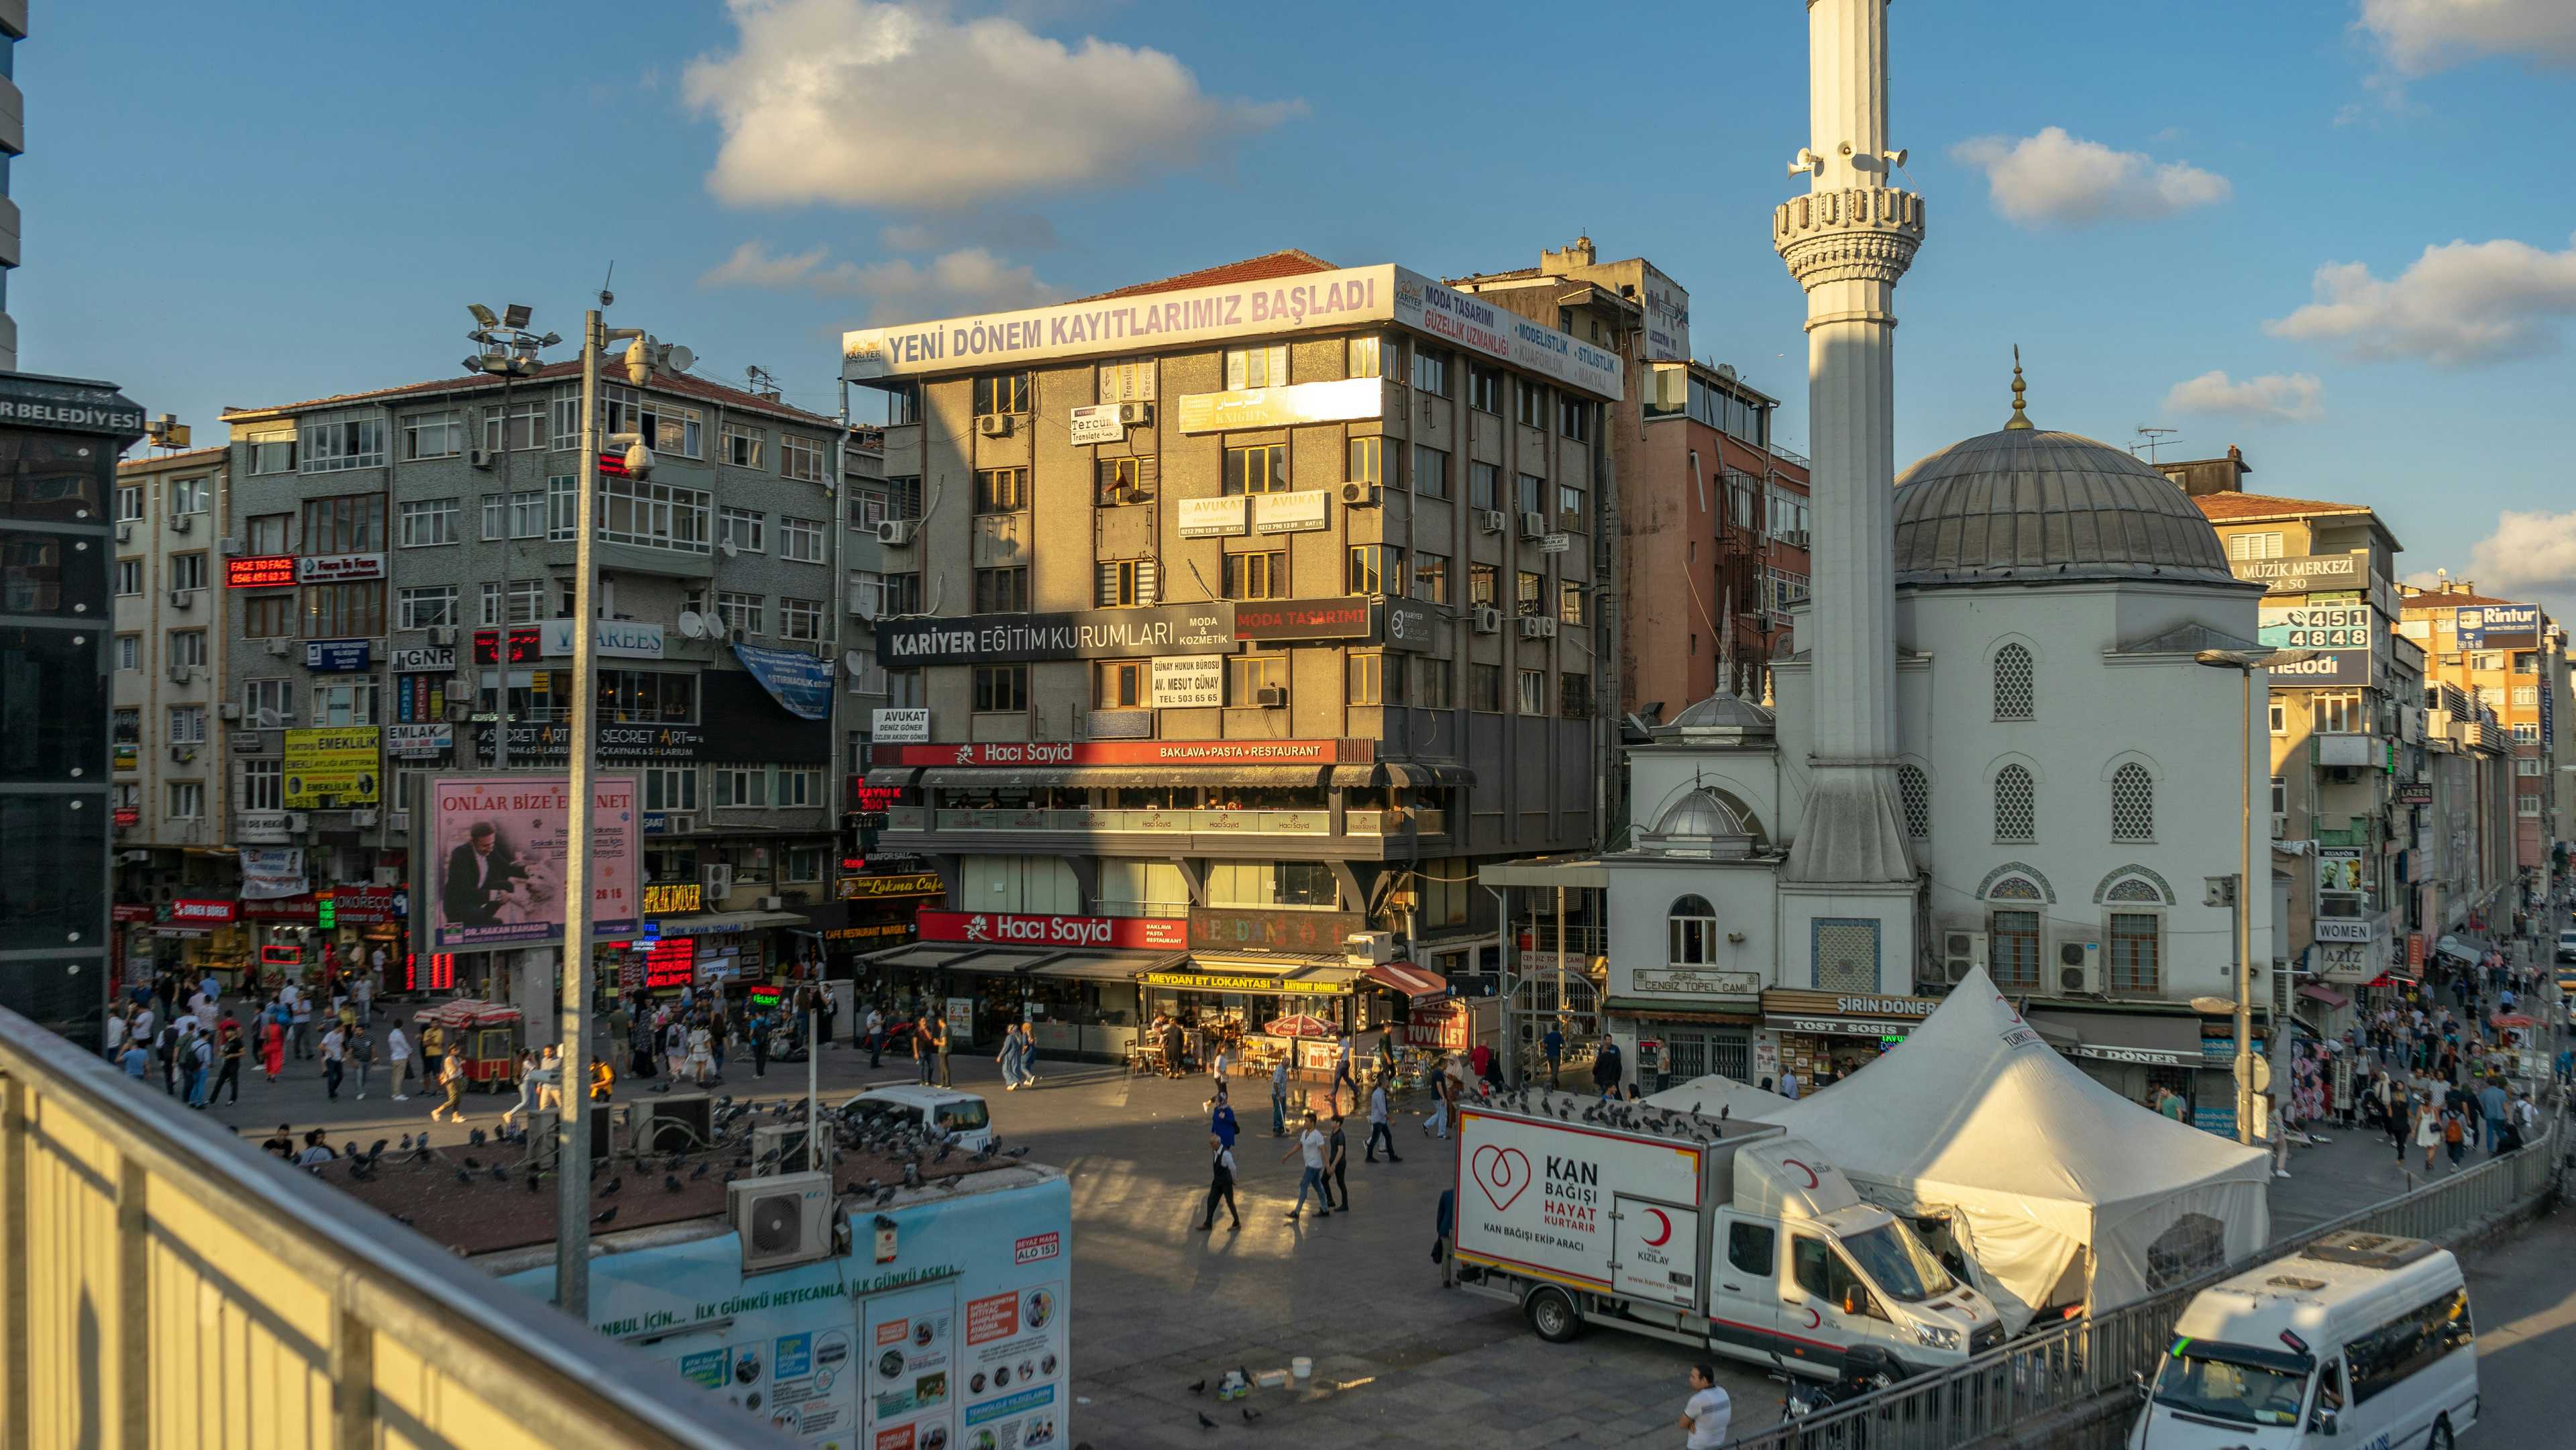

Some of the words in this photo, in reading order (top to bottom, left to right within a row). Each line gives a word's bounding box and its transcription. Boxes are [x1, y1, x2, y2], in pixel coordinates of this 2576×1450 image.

[1426, 284, 1452, 311] MODA
[1454, 296, 1494, 328] TASARIMI
[888, 324, 944, 364] YENİ
[953, 320, 1042, 357] DÖNEM
[1051, 294, 1242, 345] KAYITLARIMIZ
[1251, 278, 1375, 325] BAŞLADI
[1424, 309, 1464, 342] GÜZELLİK
[1466, 325, 1509, 357] UZMANLIĞI
[1519, 322, 1568, 356] MODELİSTLİK
[1519, 348, 1564, 374] KUAFÖRLÜK
[1578, 346, 1615, 374] STİLİSTLİK
[1578, 366, 1606, 391] MAKYAJ
[17, 403, 142, 429] BELEDİYESİ
[1215, 410, 1268, 424] KNIGHTS
[1073, 432, 1100, 441] Translate
[1194, 499, 1244, 512] AVUKAT
[1271, 493, 1322, 507] AVUKAT
[2243, 561, 2290, 578] MÜZİK
[2292, 557, 2354, 576] MERKEZİ
[2288, 578, 2307, 589] 50
[1189, 617, 1218, 627] MODA
[1237, 613, 1283, 627] MODA
[2483, 607, 2536, 623] Rintur
[892, 627, 976, 656] KARİYER
[981, 623, 1046, 652] EĞİTİM
[1052, 621, 1173, 649] KURUMLARI
[1200, 627, 1207, 635] &
[1179, 634, 1228, 645] KOZMETİK
[408, 651, 453, 665] GNR
[1155, 661, 1173, 671] GÜNAY
[1175, 662, 1194, 670] HUKUK
[1195, 660, 1219, 670] BÜROSU
[1155, 682, 1165, 691] AV.
[1168, 678, 1191, 690] MESUT
[1195, 674, 1219, 690] GÜNAY
[1159, 695, 1175, 703] TEL:
[1178, 694, 1193, 703] 503
[1195, 694, 1205, 702] 65
[1208, 694, 1218, 702] 65
[884, 711, 926, 721] AVUKAT
[390, 726, 437, 739] EMLAK
[602, 729, 655, 743] SECRET
[660, 729, 688, 745] ART
[985, 744, 1022, 761] Hacı
[1026, 743, 1072, 764] Sayid
[1160, 747, 1205, 758] BAKLAVA
[1211, 746, 1244, 757] PASTA
[1250, 745, 1321, 757] RESTAURANT
[2401, 787, 2430, 798] LAZER
[443, 796, 508, 811] ONLAR
[513, 794, 552, 809] BİZE
[1156, 821, 1171, 829] Sayid
[1223, 821, 1239, 829] Sayid
[1293, 822, 1309, 830] Sayid
[869, 879, 914, 895] Lokma
[666, 926, 687, 935] TÜRK
[689, 925, 709, 933] HAVA
[713, 923, 741, 932] YOLLARI
[843, 927, 879, 939] RESTAURANT
[998, 916, 1045, 940] Hacı
[1051, 917, 1112, 945] Sayid
[2320, 925, 2367, 937] WOMEN
[1148, 974, 1193, 986] MEYDAN
[1195, 976, 1208, 986] ET
[1212, 977, 1271, 988] LOKANTASI
[1283, 980, 1313, 991] BAYBURT
[1313, 980, 1338, 992] DÖNERİ
[1685, 982, 1718, 992] TOPEL
[1837, 996, 1878, 1015] ŞİRİN
[1882, 997, 1936, 1015] DÖNER
[1408, 1024, 1465, 1045] TUVALET
[1793, 1020, 1837, 1032] TOST
[1847, 1023, 1896, 1035] SOSİS
[2106, 1047, 2180, 1064] DÖNER
[1546, 1155, 1598, 1186] KAN
[1545, 1181, 1597, 1205] BAĞIŞI
[1545, 1199, 1597, 1221] HAYAT
[1544, 1215, 1596, 1234] KURTARIR
[1016, 1238, 1038, 1248] BEYAZ
[1039, 1234, 1058, 1244] MASA
[1484, 1222, 1502, 1235] KAN
[1503, 1225, 1533, 1243] BAĞIŞI
[1534, 1231, 1556, 1246] EKİP
[1556, 1238, 1584, 1252] ARACI
[1018, 1248, 1038, 1260] ALO
[1041, 1243, 1056, 1255] 153
[1638, 1251, 1669, 1265] KIZILAY
[1627, 1275, 1678, 1293] www.kanver.org
[695, 1303, 715, 1320] İLK
[720, 1292, 769, 1314] GÜNKÜ
[772, 1282, 847, 1308] HEYECANLA,
[851, 1276, 870, 1294] İLK
[873, 1272, 917, 1290] GÜNKÜ
